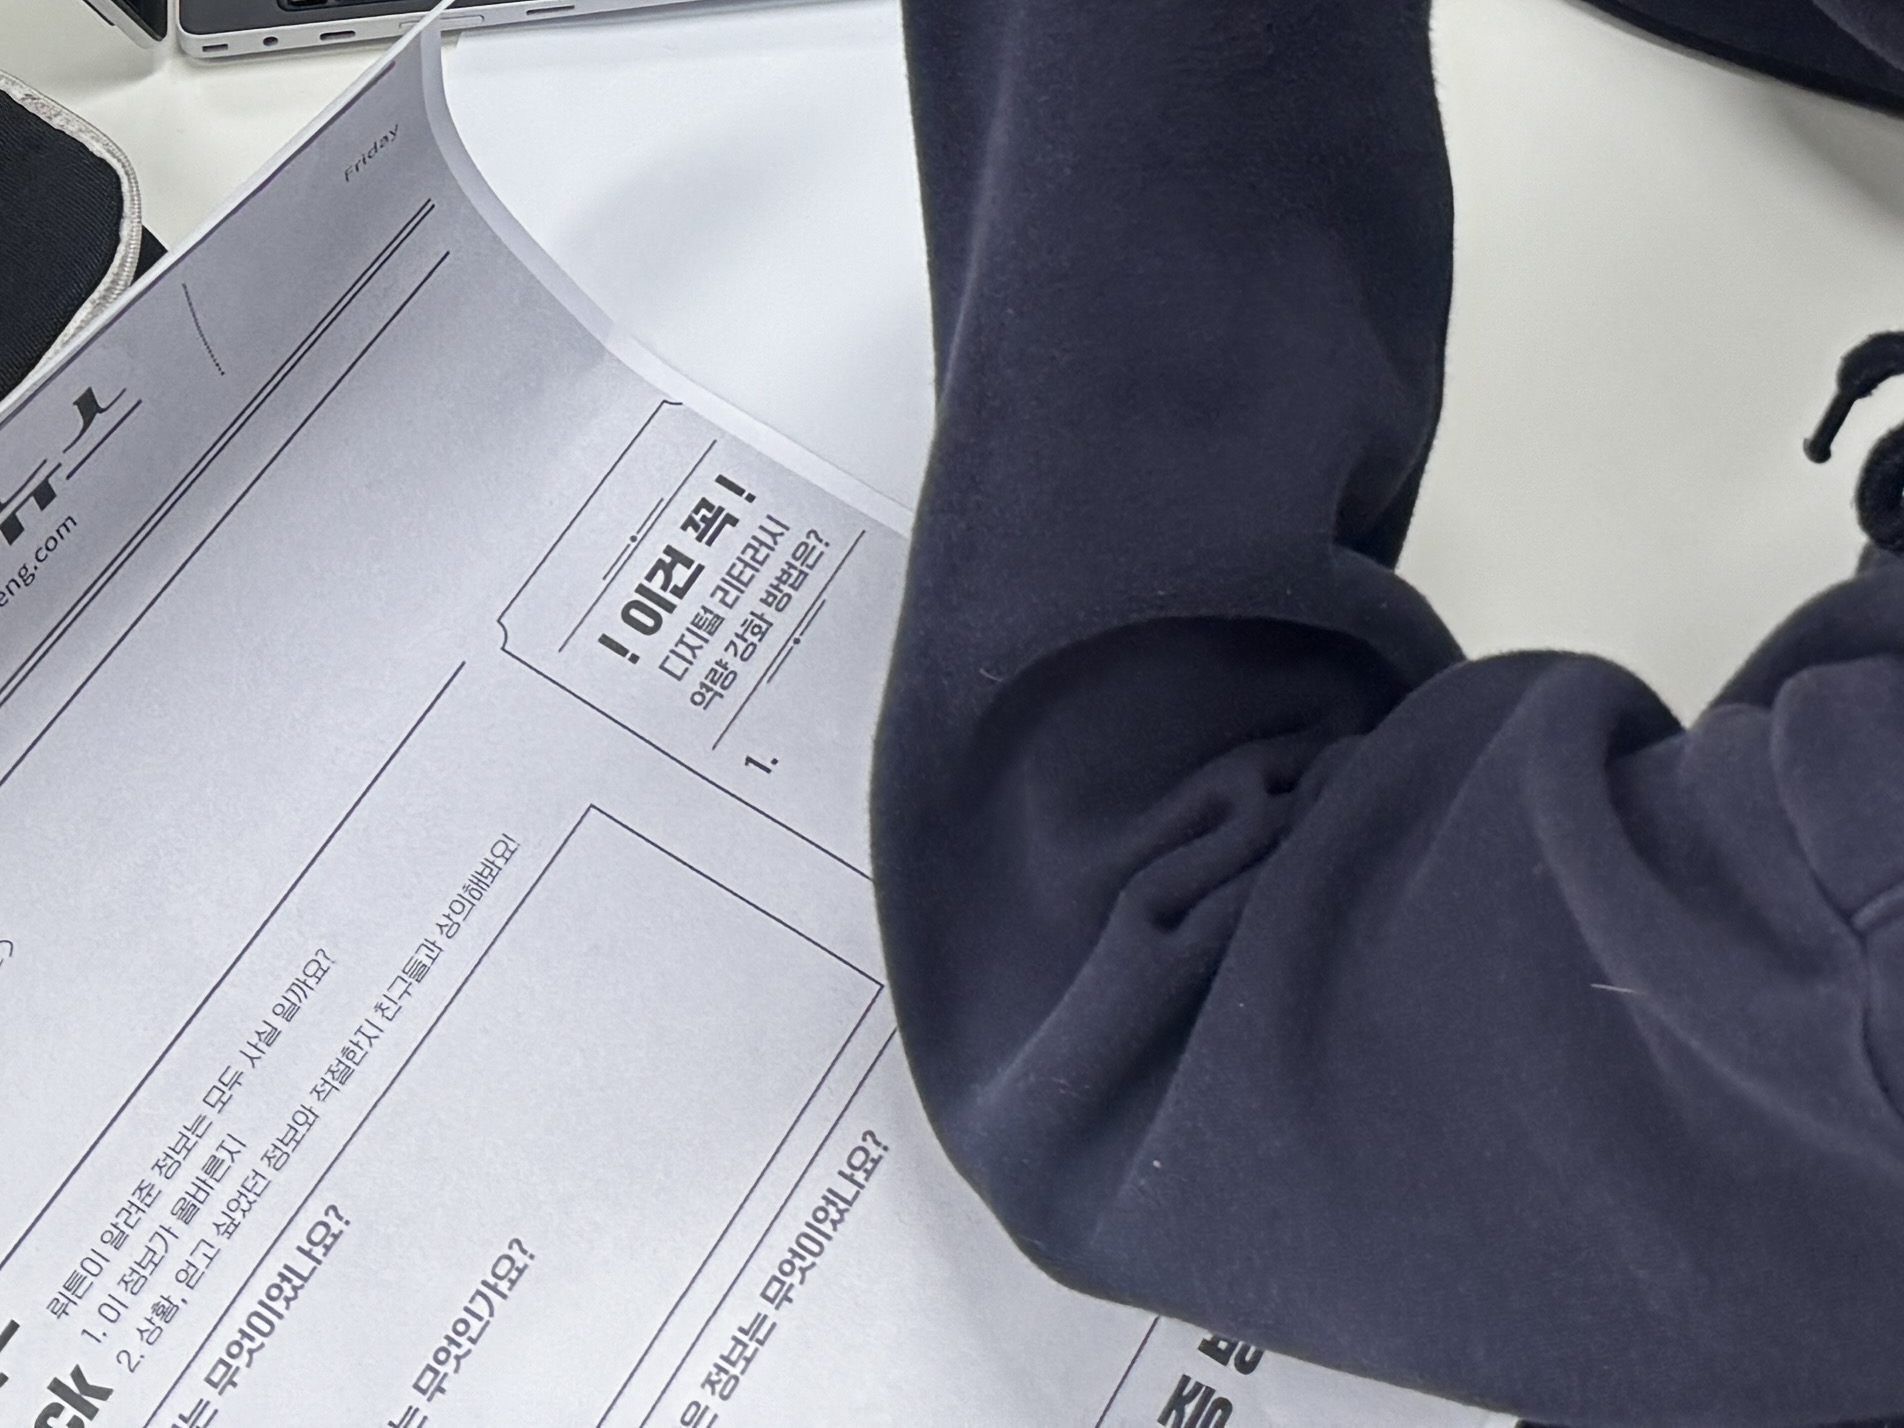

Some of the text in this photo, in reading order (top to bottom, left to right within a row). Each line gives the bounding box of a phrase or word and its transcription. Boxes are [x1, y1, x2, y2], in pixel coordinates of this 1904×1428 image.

[343, 123, 400, 183] Friday
[620, 543, 707, 637] 이건
[679, 496, 741, 548] 꼭
[657, 513, 792, 682] 디지털 리터러시
[689, 528, 831, 711] 역량 강화 방법은?
[744, 754, 780, 775] 1.
[46, 947, 338, 1320] 뤼튼이 알려준 정보는 모두 사실 일까요?
[115, 831, 521, 1375] 2. 상황, 얻고 싶었던 정보와 적절한지 친구들과 상의해봐요!
[80, 1132, 249, 1345] 1. 이 정보가 올바른지
[202, 1203, 352, 1397] 무엇이었나요?
[411, 1236, 536, 1404] 무엇인가요?
[699, 1311, 778, 1402] 정보는
[758, 1129, 890, 1312] 무엇이었나요?
